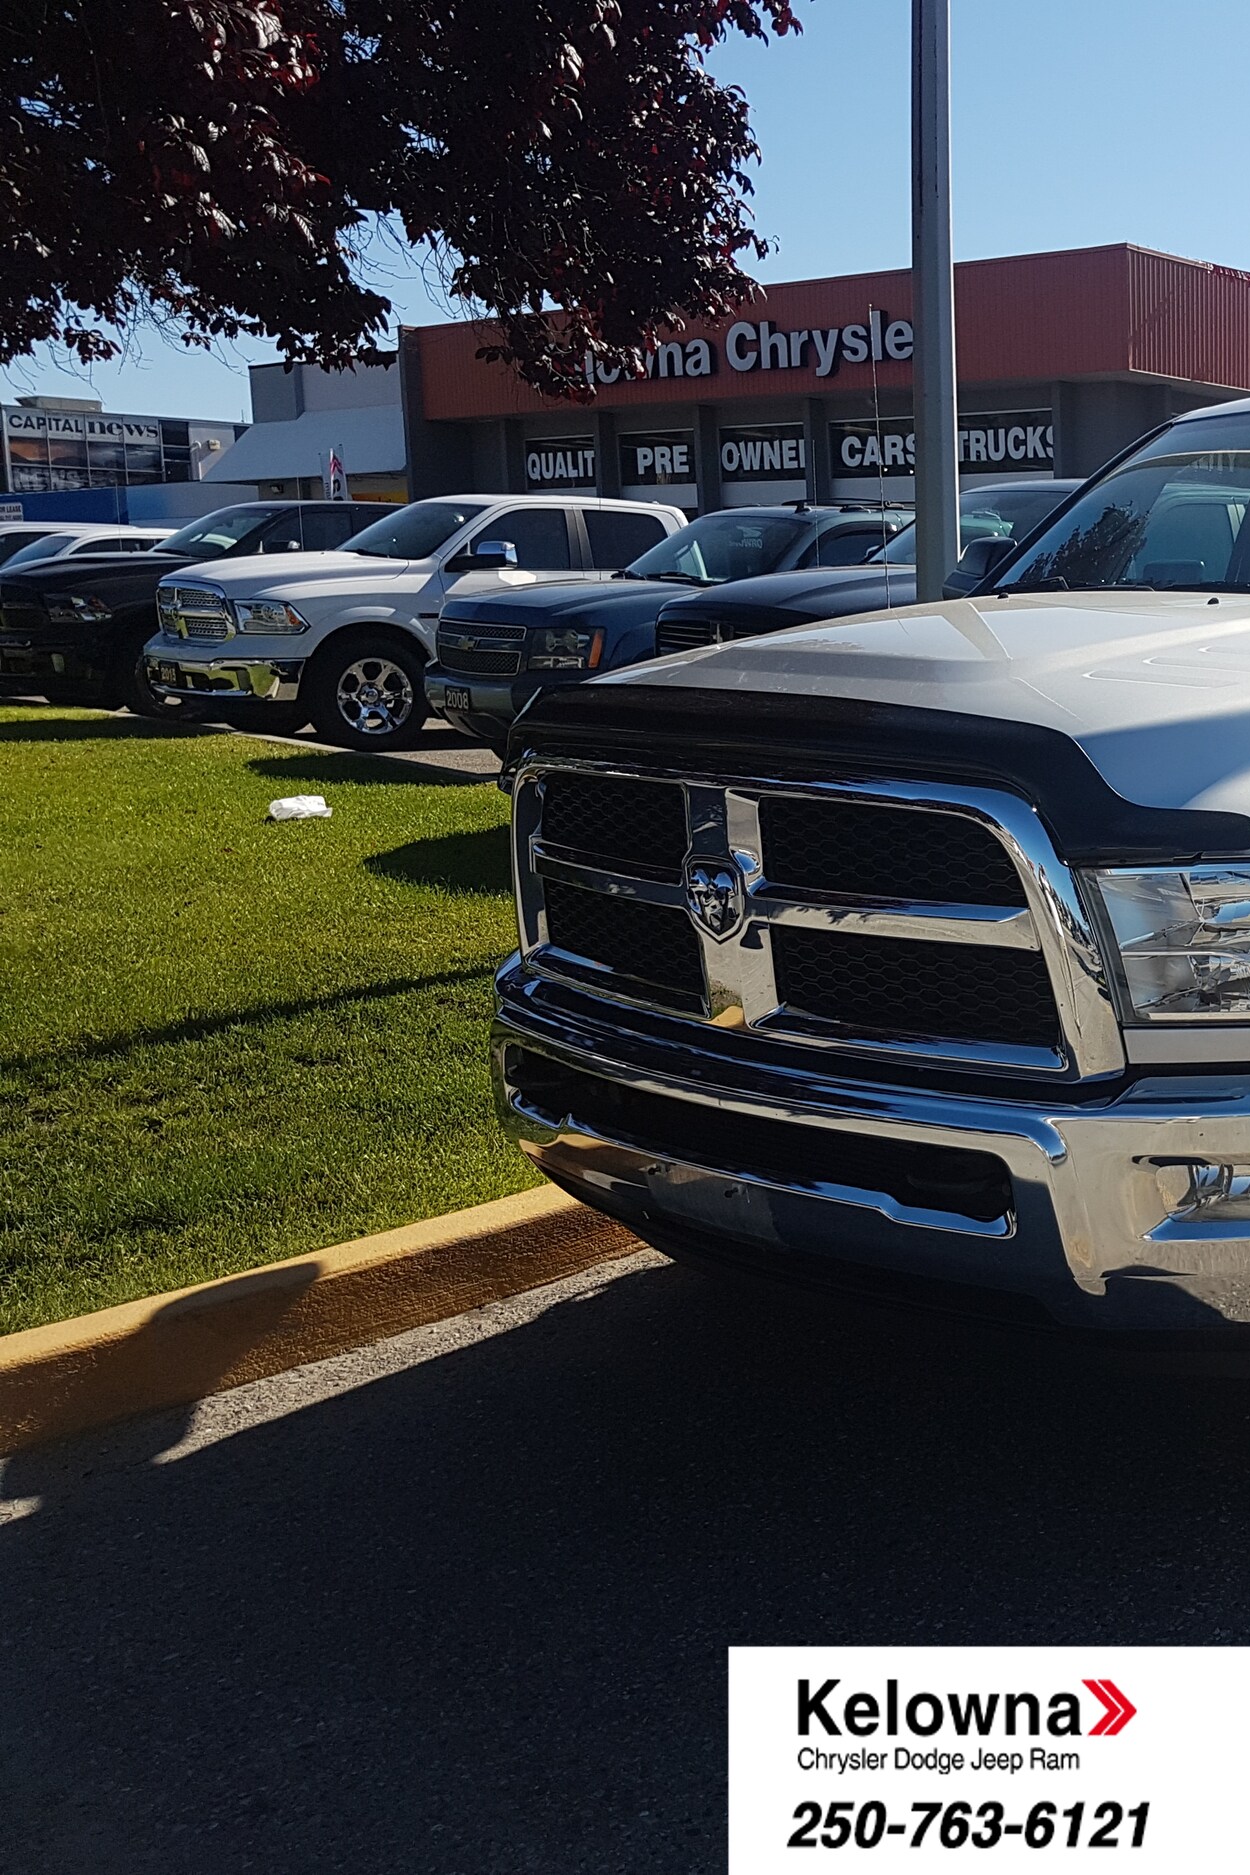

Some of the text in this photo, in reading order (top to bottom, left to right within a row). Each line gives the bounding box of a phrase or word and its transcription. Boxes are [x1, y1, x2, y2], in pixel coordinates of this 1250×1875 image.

[725, 310, 914, 376] Chrysle
[8, 414, 83, 434] CAPITAL
[87, 420, 159, 439] news
[526, 449, 595, 482] QUALIT
[636, 444, 690, 475] PRE
[841, 432, 916, 468] CARS
[446, 689, 469, 710] 2008
